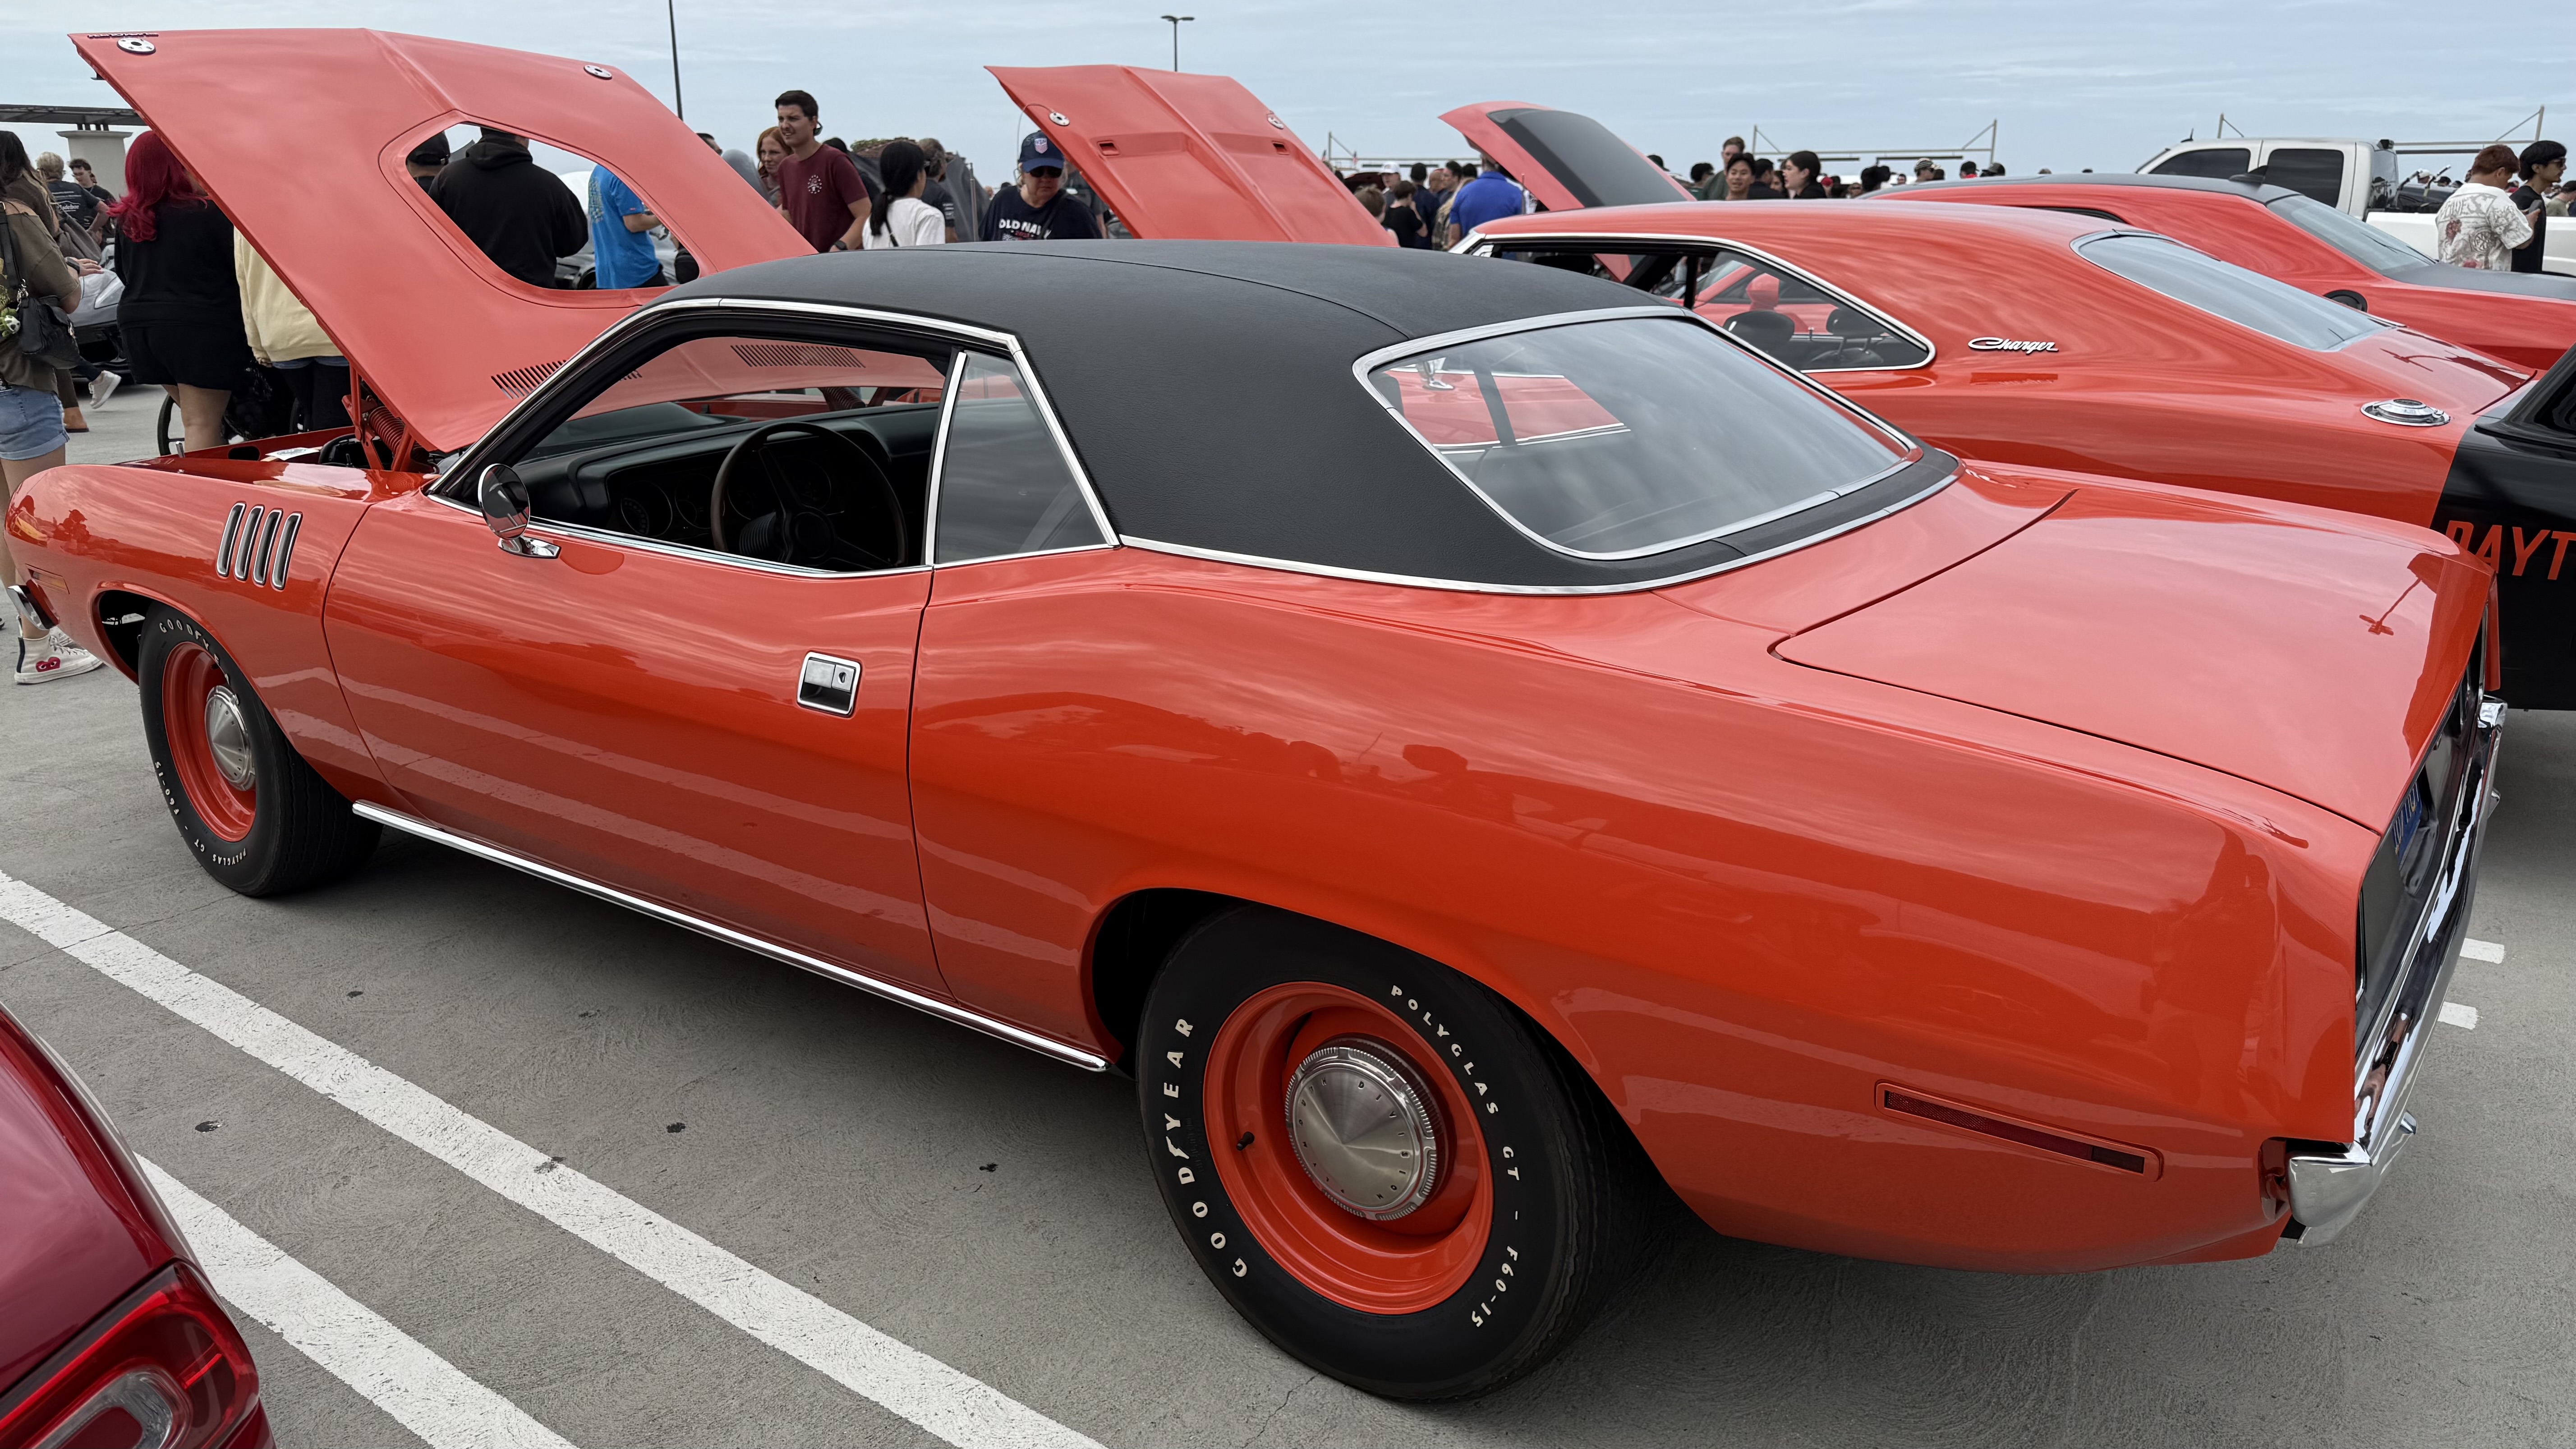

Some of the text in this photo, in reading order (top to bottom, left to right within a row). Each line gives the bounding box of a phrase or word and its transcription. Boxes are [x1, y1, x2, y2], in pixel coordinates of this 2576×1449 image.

[999, 219, 1021, 230] OLD
[1968, 337, 2059, 354] Charger
[194, 839, 204, 852] GT
[212, 848, 246, 866] POLYGLAS
[1391, 985, 1498, 1113] POLYGLAS
[1164, 1018, 1247, 1277] GOODYEAR
[1358, 1081, 1410, 1200] DIVISION
[1503, 1146, 1519, 1181] GT
[1472, 1245, 1518, 1327] F60-15
